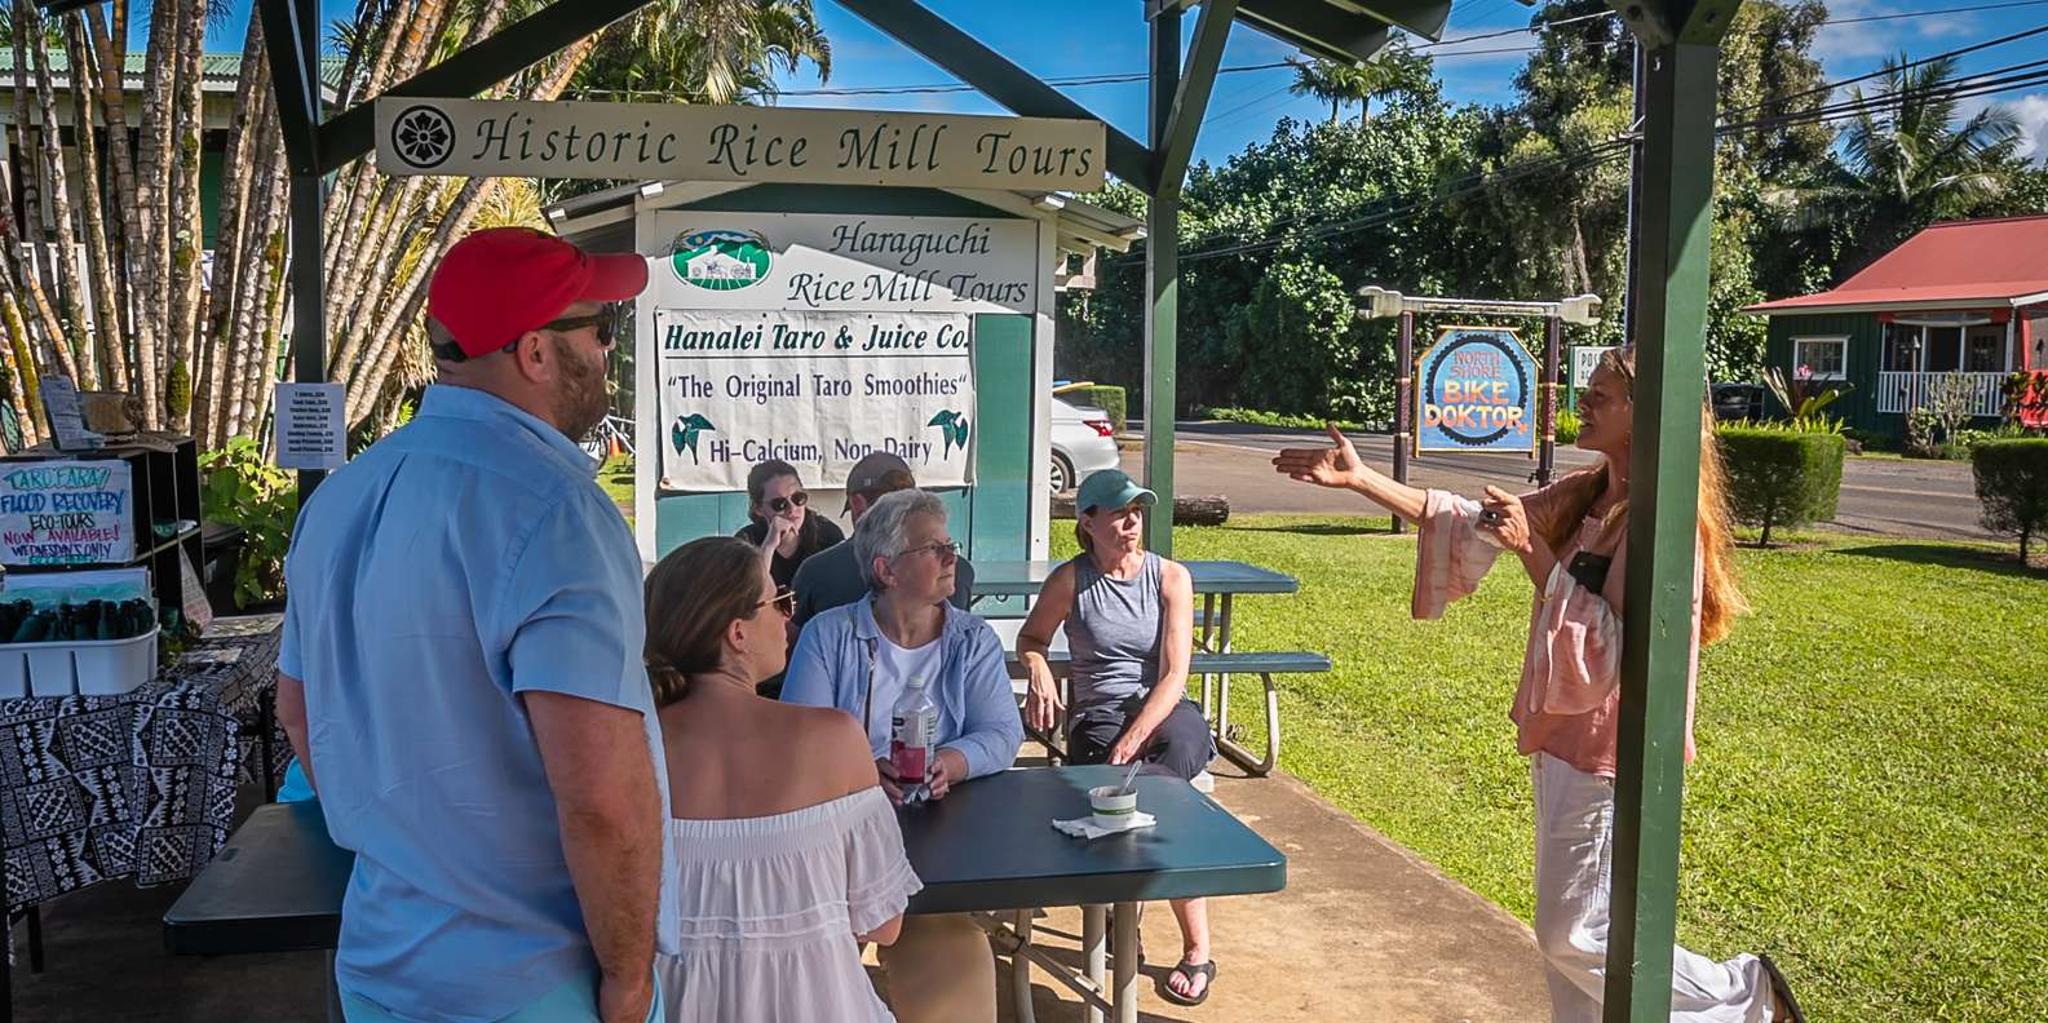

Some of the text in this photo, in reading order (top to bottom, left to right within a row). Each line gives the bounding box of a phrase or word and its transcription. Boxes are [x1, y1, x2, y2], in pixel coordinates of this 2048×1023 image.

[472, 111, 1093, 178] Historic Rice Mill Tours
[830, 220, 990, 266] Haraguchi
[787, 270, 1029, 307] Rice Mill Tours
[665, 323, 969, 351] Hanalei Taro & Juice Co.
[1450, 365, 1501, 378] SHORE
[1455, 351, 1500, 367] NORTH
[725, 373, 801, 404] Original
[813, 374, 851, 397] Taro
[1443, 379, 1510, 405] BIKE
[710, 437, 933, 464] Hi-Calcium, Non-Dairy
[0, 490, 124, 514] FLOOD RECOVERY
[4, 531, 35, 545] NOW
